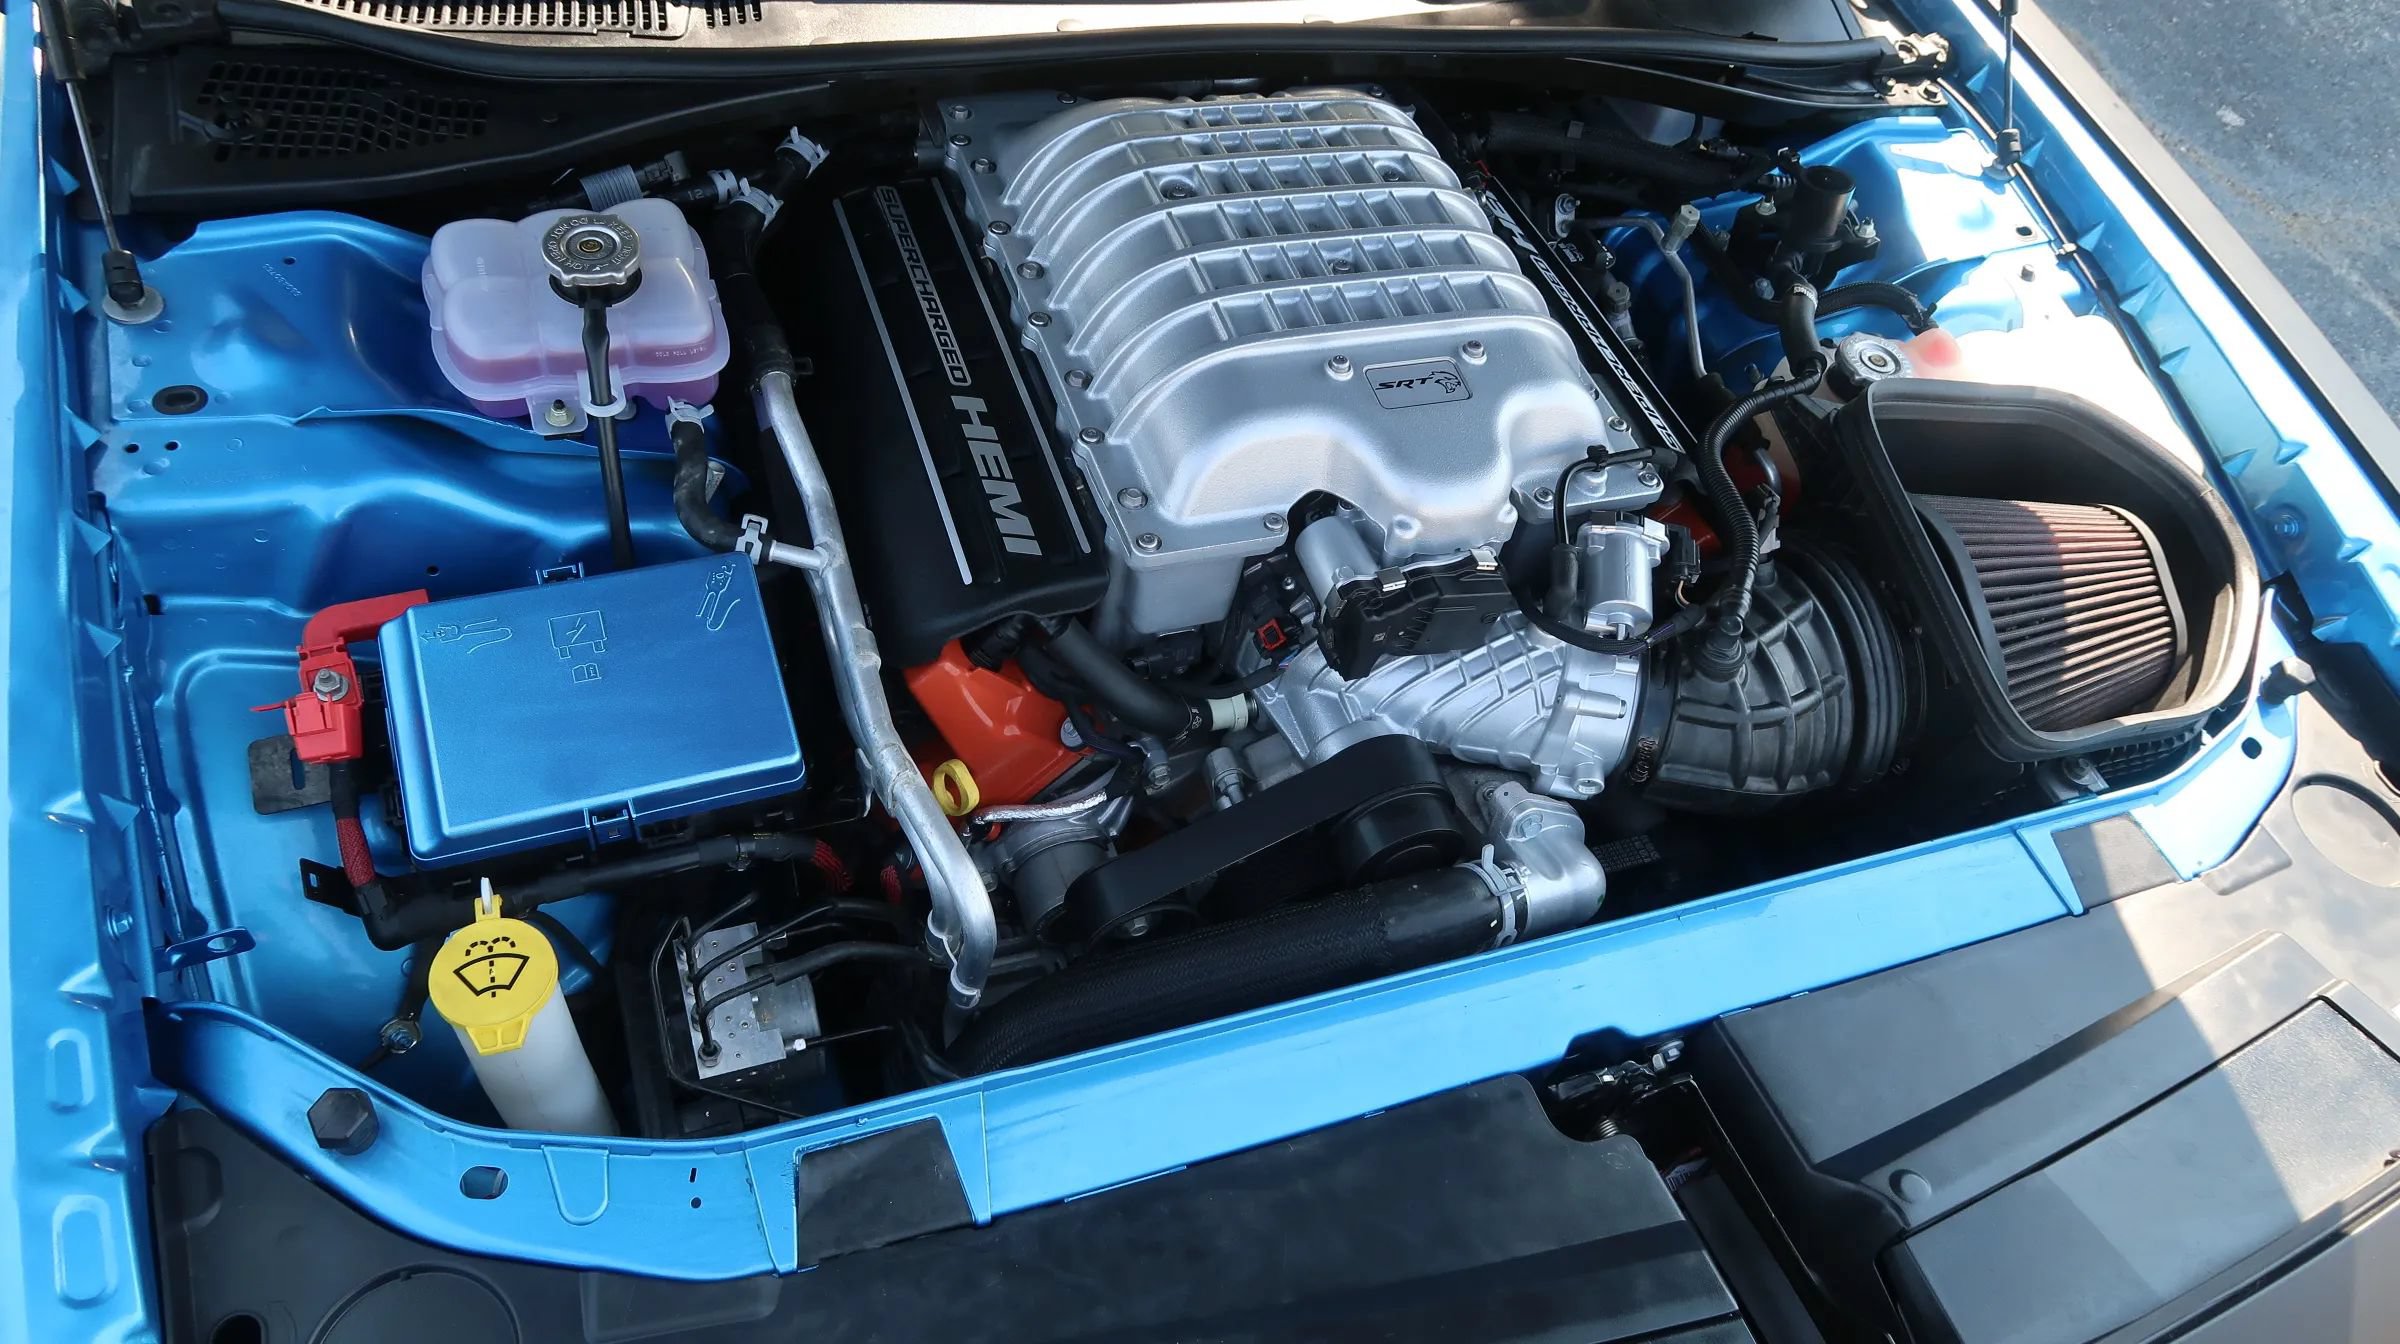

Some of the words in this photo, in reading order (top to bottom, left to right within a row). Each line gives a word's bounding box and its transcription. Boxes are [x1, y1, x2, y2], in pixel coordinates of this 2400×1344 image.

[687, 188, 705, 201] 12
[874, 185, 972, 387] SUPERCHARGED
[950, 395, 1043, 556] HEMI
[1375, 377, 1434, 391] SRT
[1529, 254, 1687, 454] SUPERCHARGED
